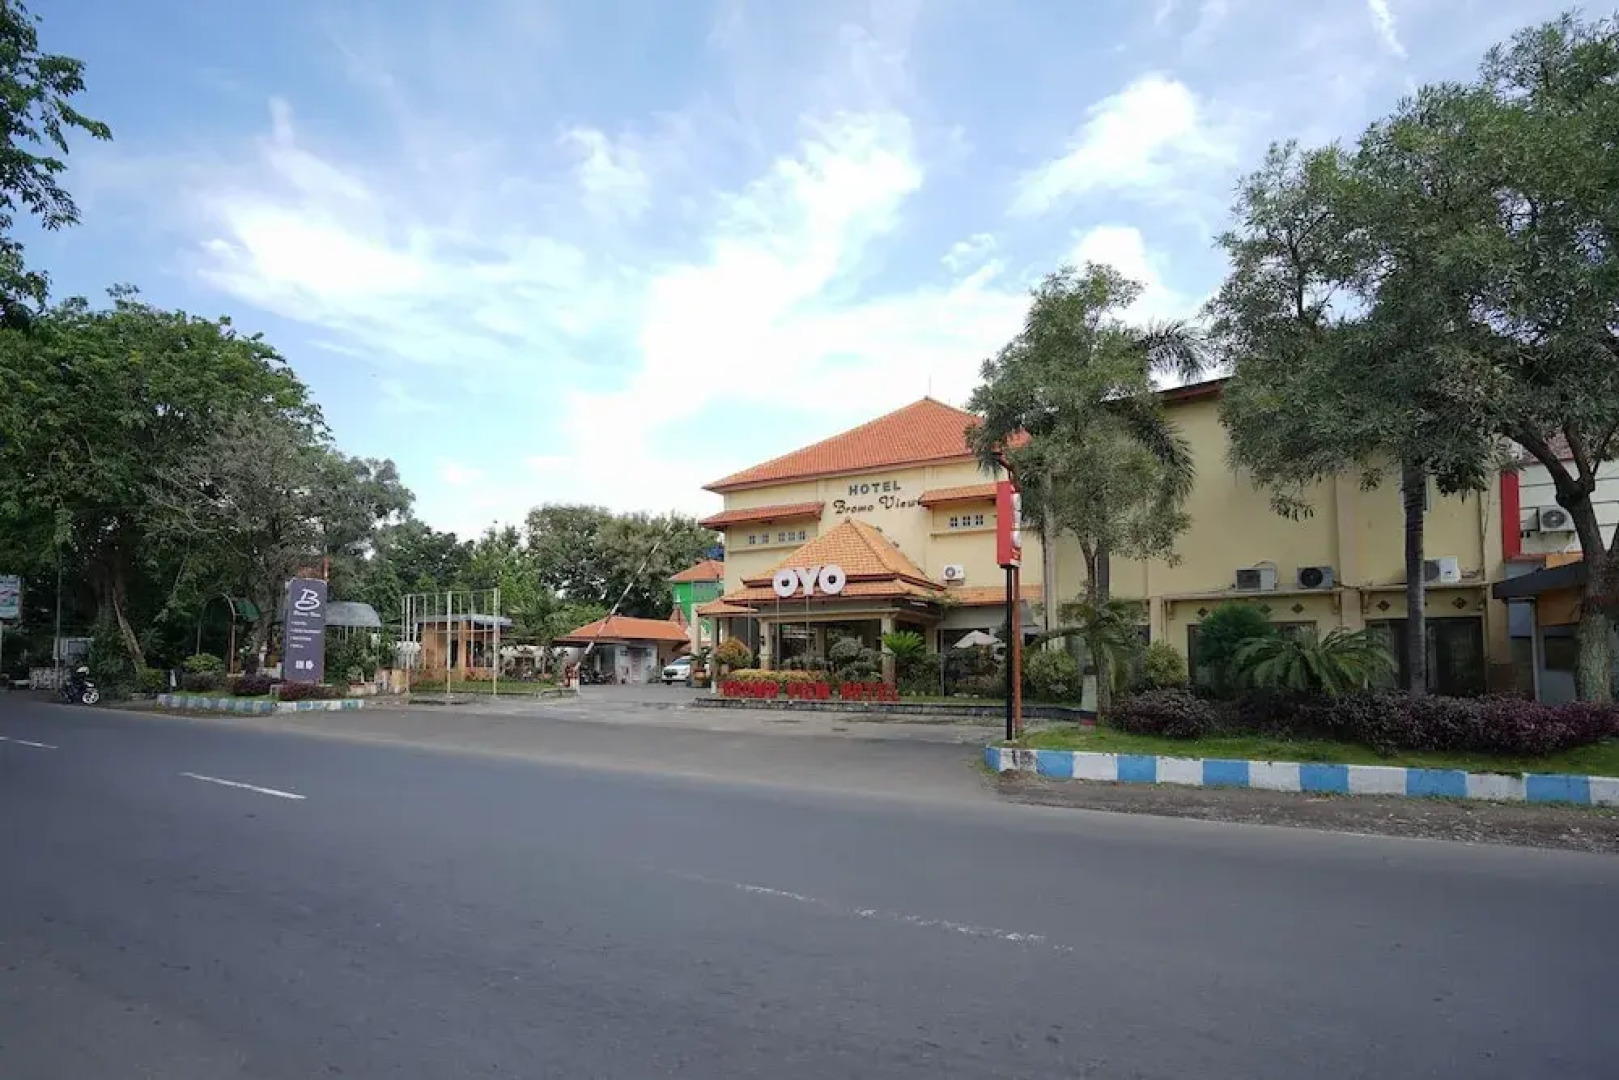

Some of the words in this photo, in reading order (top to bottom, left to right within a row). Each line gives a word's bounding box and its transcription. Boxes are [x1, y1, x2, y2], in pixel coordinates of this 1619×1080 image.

[849, 480, 902, 496] HOTEL
[833, 499, 875, 514] Bromo
[878, 494, 919, 510] View
[773, 564, 846, 597] OYO
